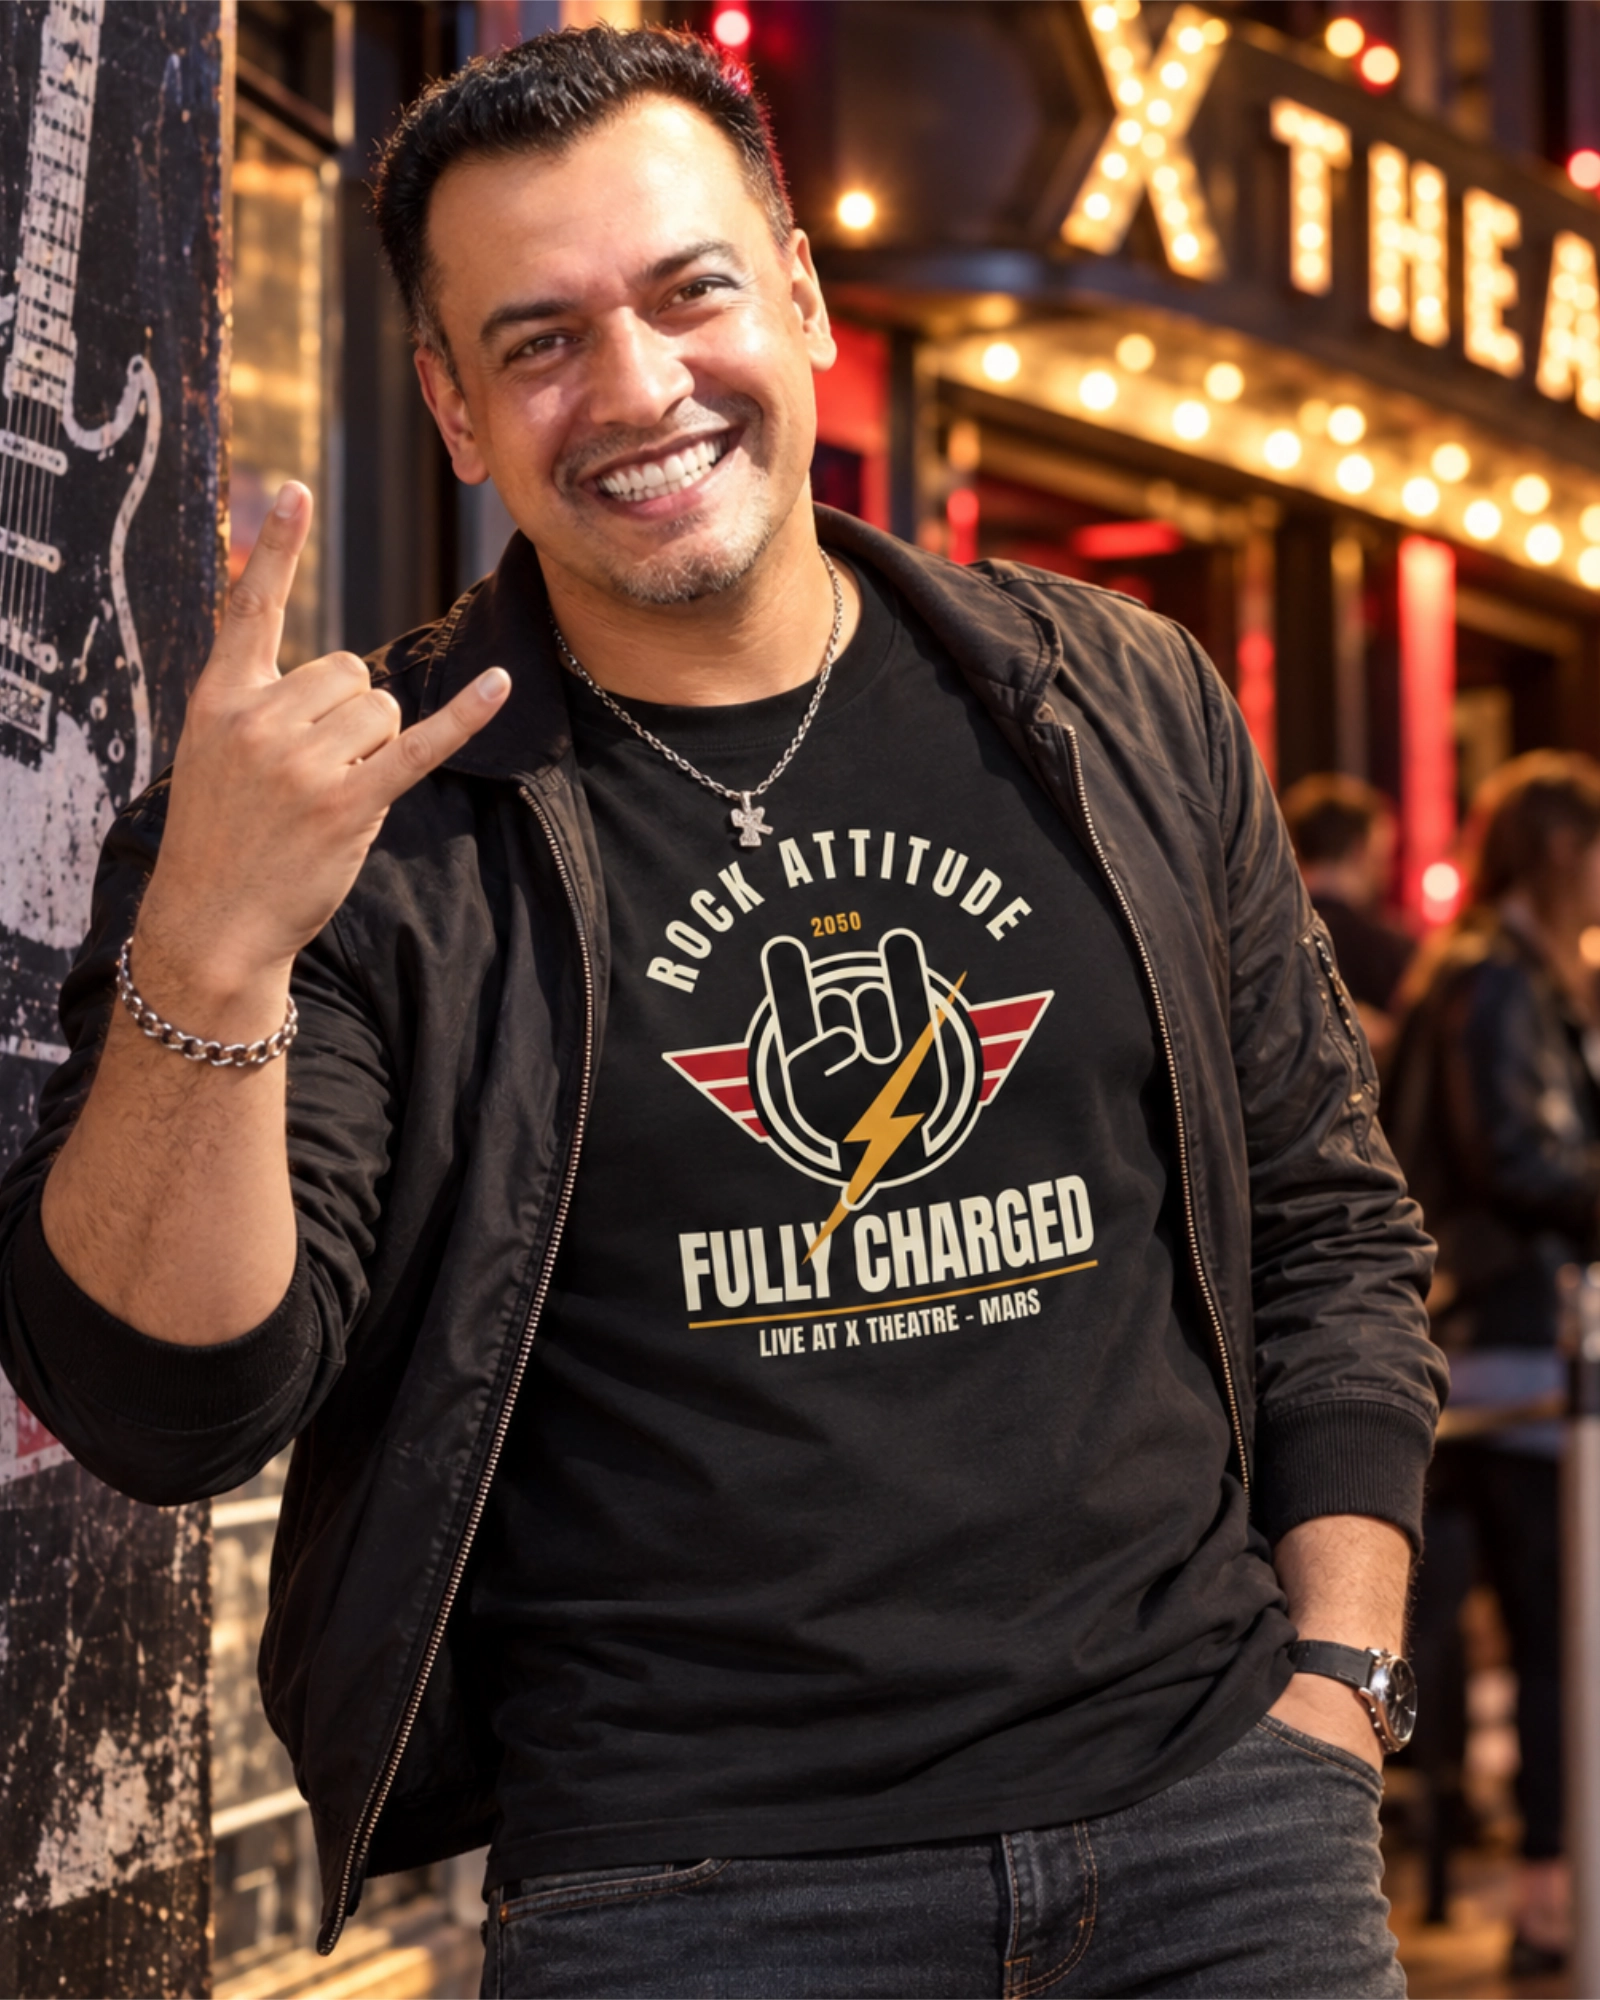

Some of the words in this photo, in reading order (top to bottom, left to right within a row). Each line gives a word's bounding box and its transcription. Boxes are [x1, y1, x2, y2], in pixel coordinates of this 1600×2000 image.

[1061, 0, 1230, 282] X
[1270, 96, 1600, 421] THEA
[646, 861, 765, 993] ROCK
[778, 828, 1033, 941] ATTITUDE
[810, 911, 862, 938] 2050
[678, 1220, 833, 1312] FULLY
[853, 1174, 1095, 1293] CHARGED
[759, 1326, 805, 1357] LIVE
[812, 1322, 839, 1351] AT
[845, 1319, 861, 1347] X
[866, 1304, 960, 1344] THEATRE
[980, 1288, 1042, 1328] MARS
